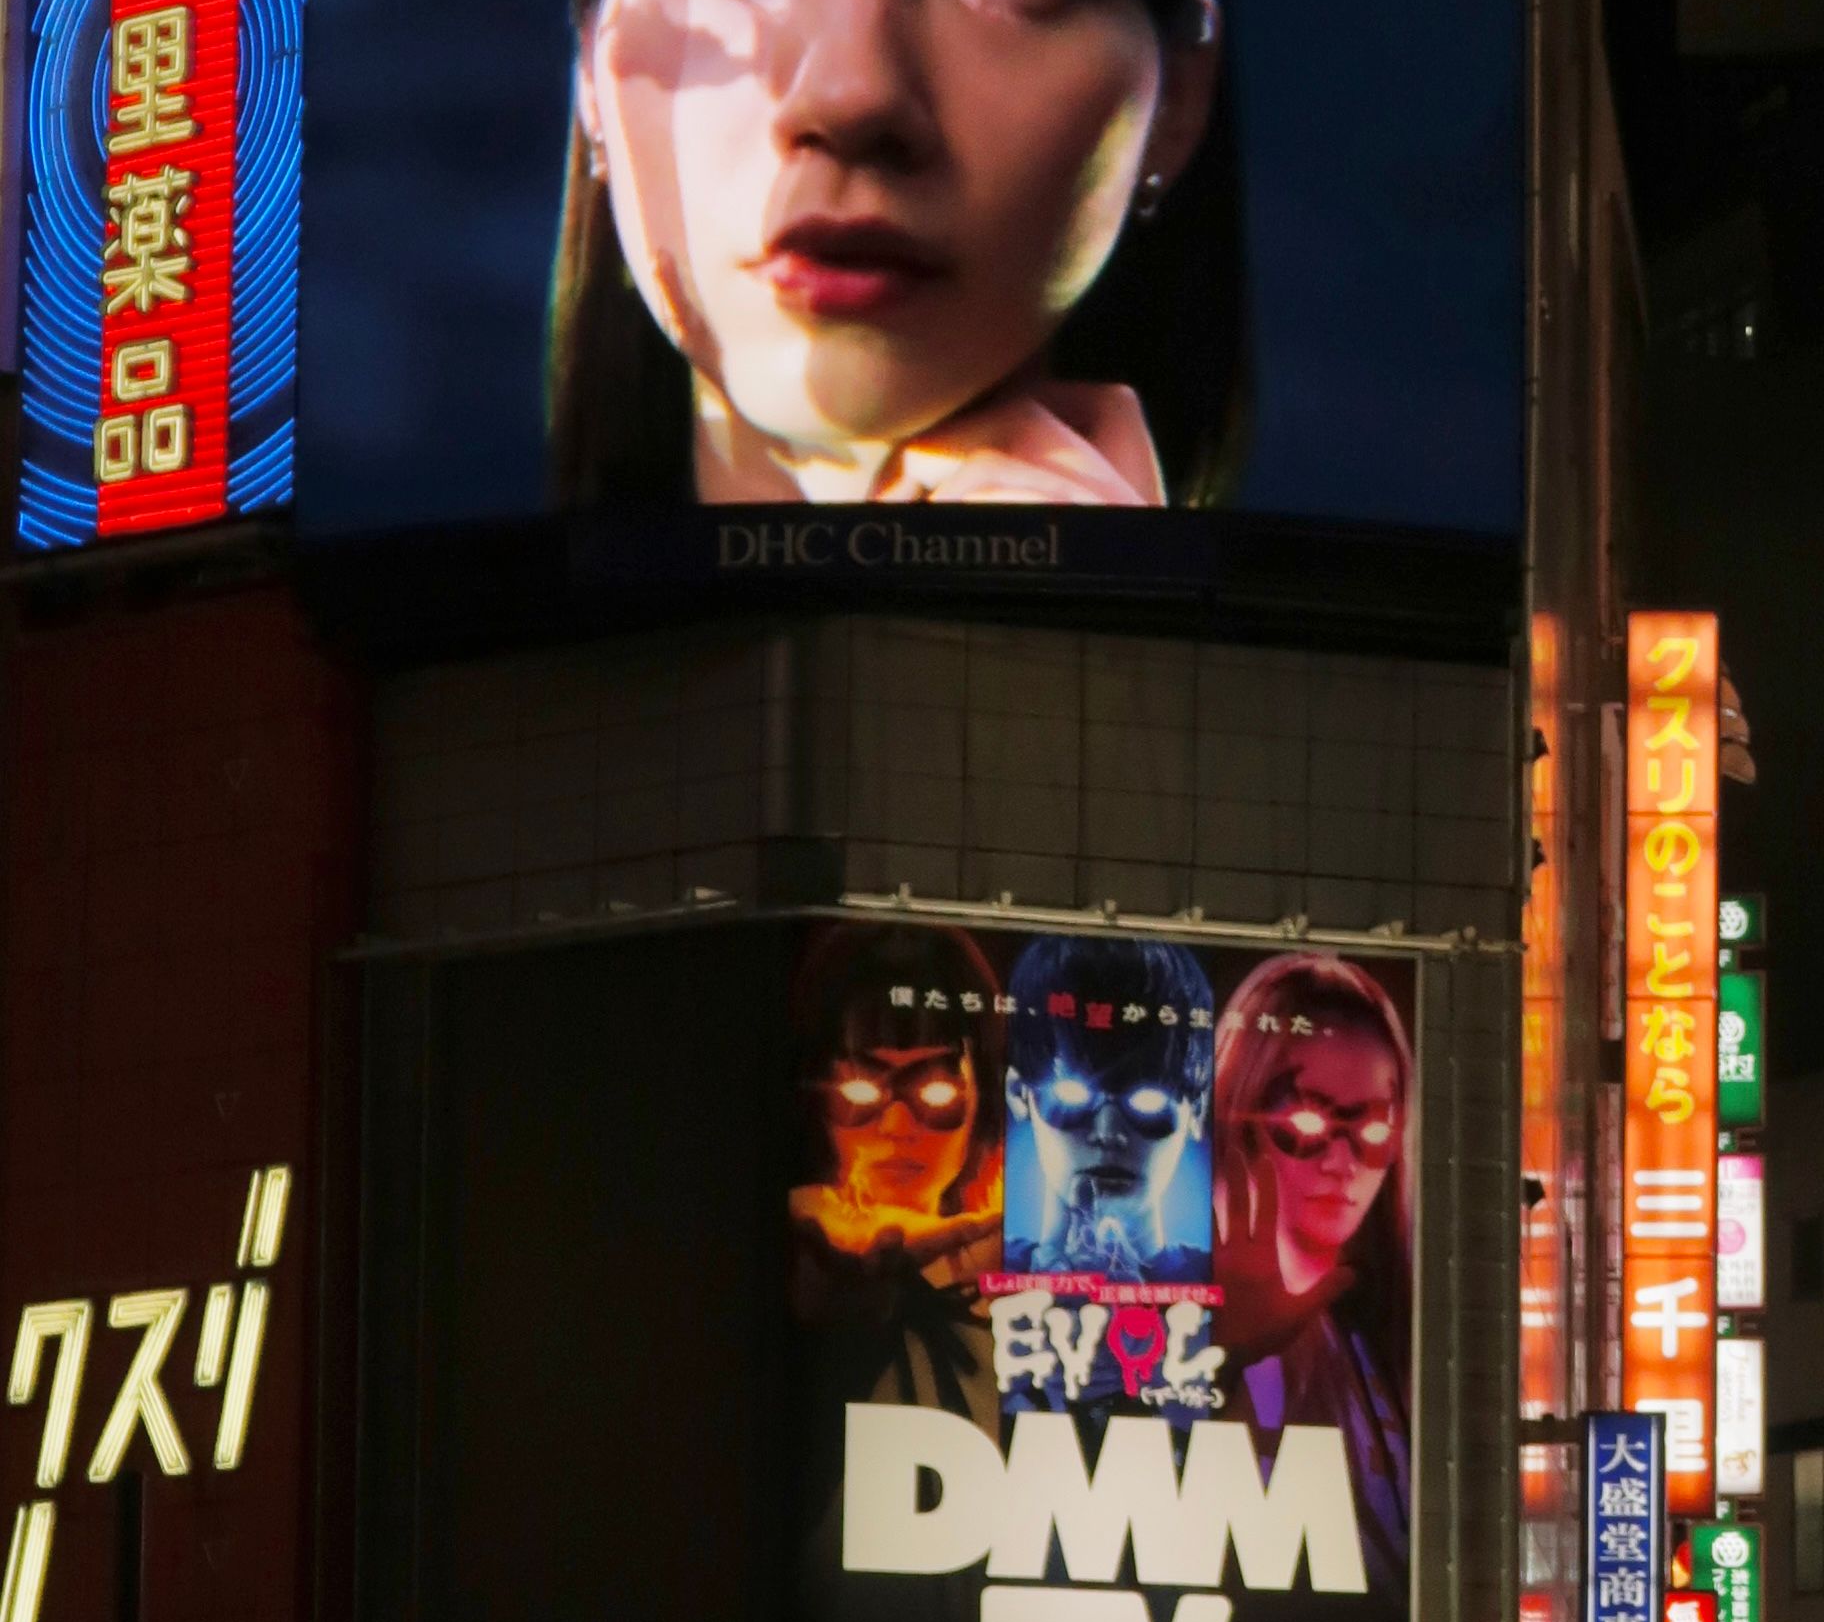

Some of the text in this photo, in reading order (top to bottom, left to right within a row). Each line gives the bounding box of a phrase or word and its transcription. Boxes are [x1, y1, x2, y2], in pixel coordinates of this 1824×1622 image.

[716, 522, 1060, 567] DHC Channel
[1640, 636, 1701, 1125] クスリのことなら
[1631, 1168, 1709, 1472] 三千里
[843, 1402, 1370, 1593] DMM
